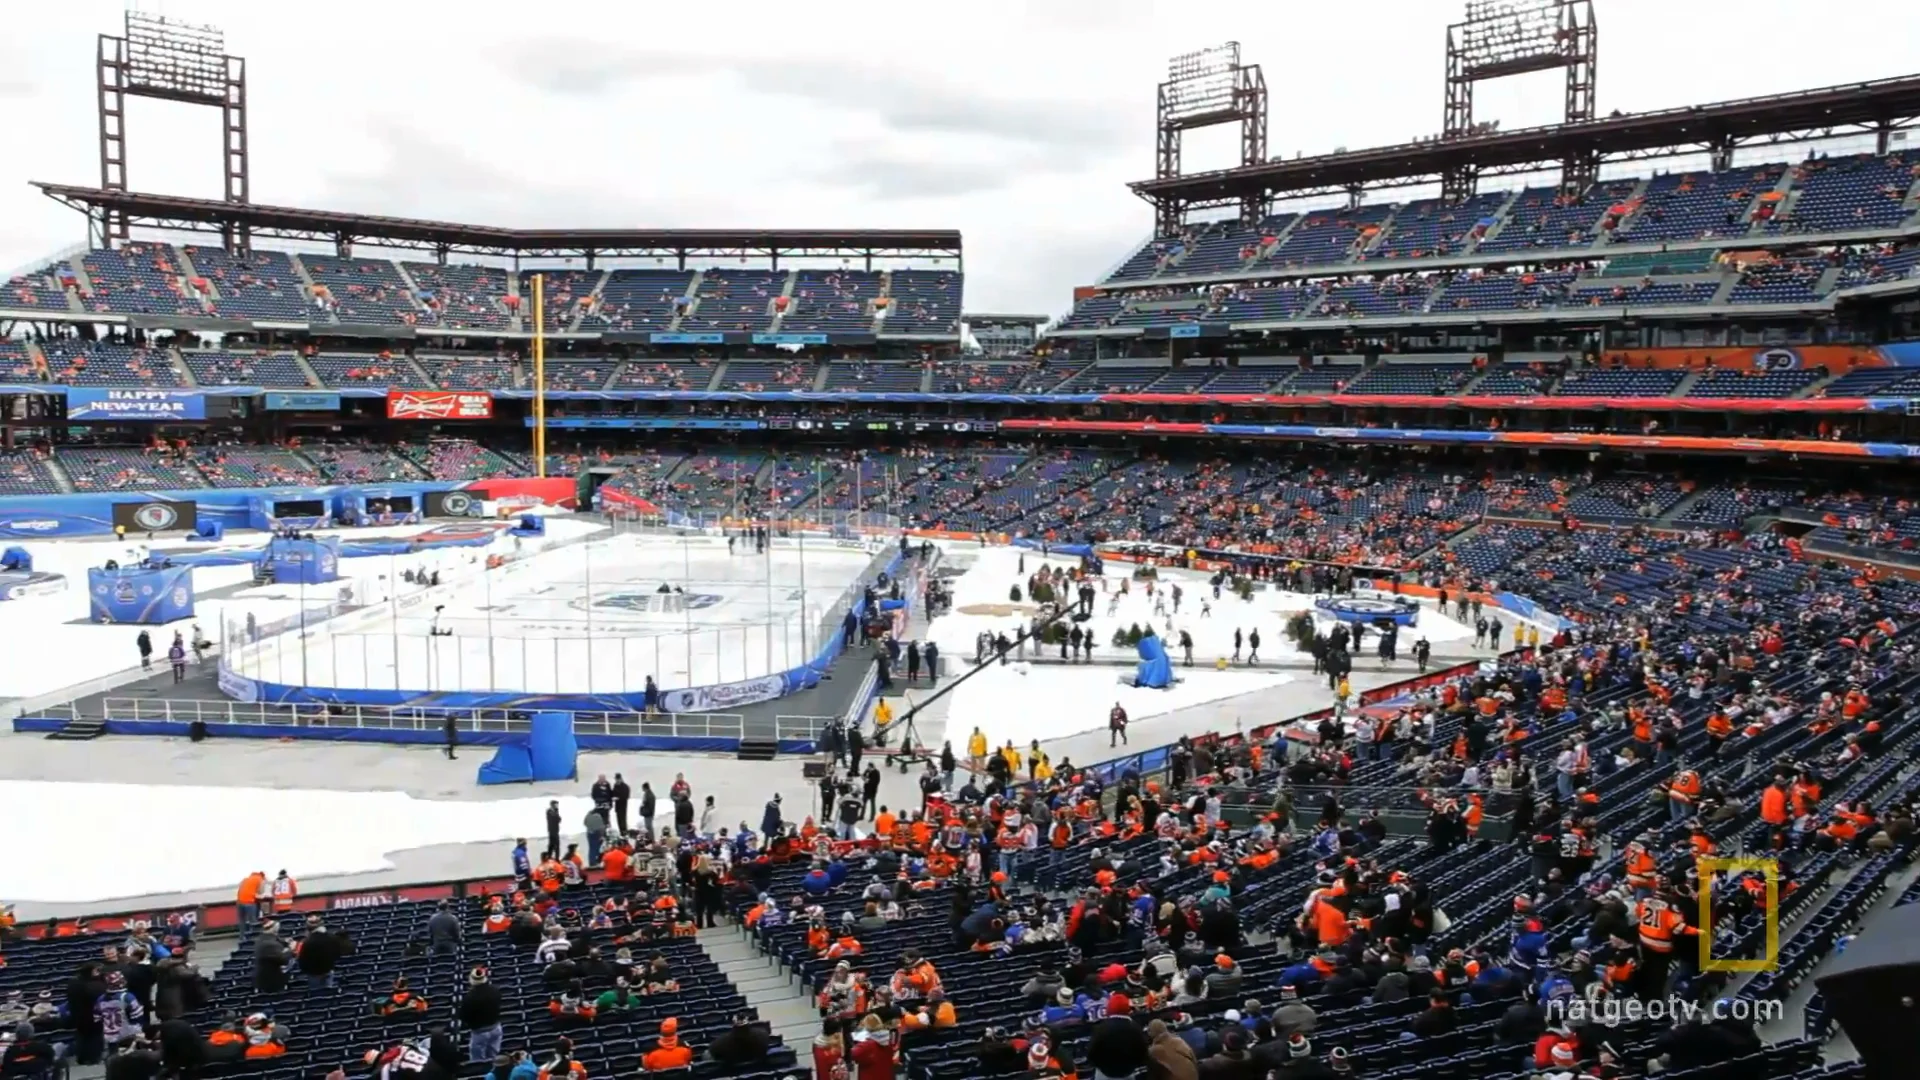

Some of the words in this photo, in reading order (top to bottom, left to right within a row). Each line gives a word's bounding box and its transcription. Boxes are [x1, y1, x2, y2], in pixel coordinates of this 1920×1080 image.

[109, 391, 169, 400] HAPPY
[91, 402, 132, 411] NEW
[135, 402, 185, 411] YEAR
[1642, 907, 1659, 928] 21
